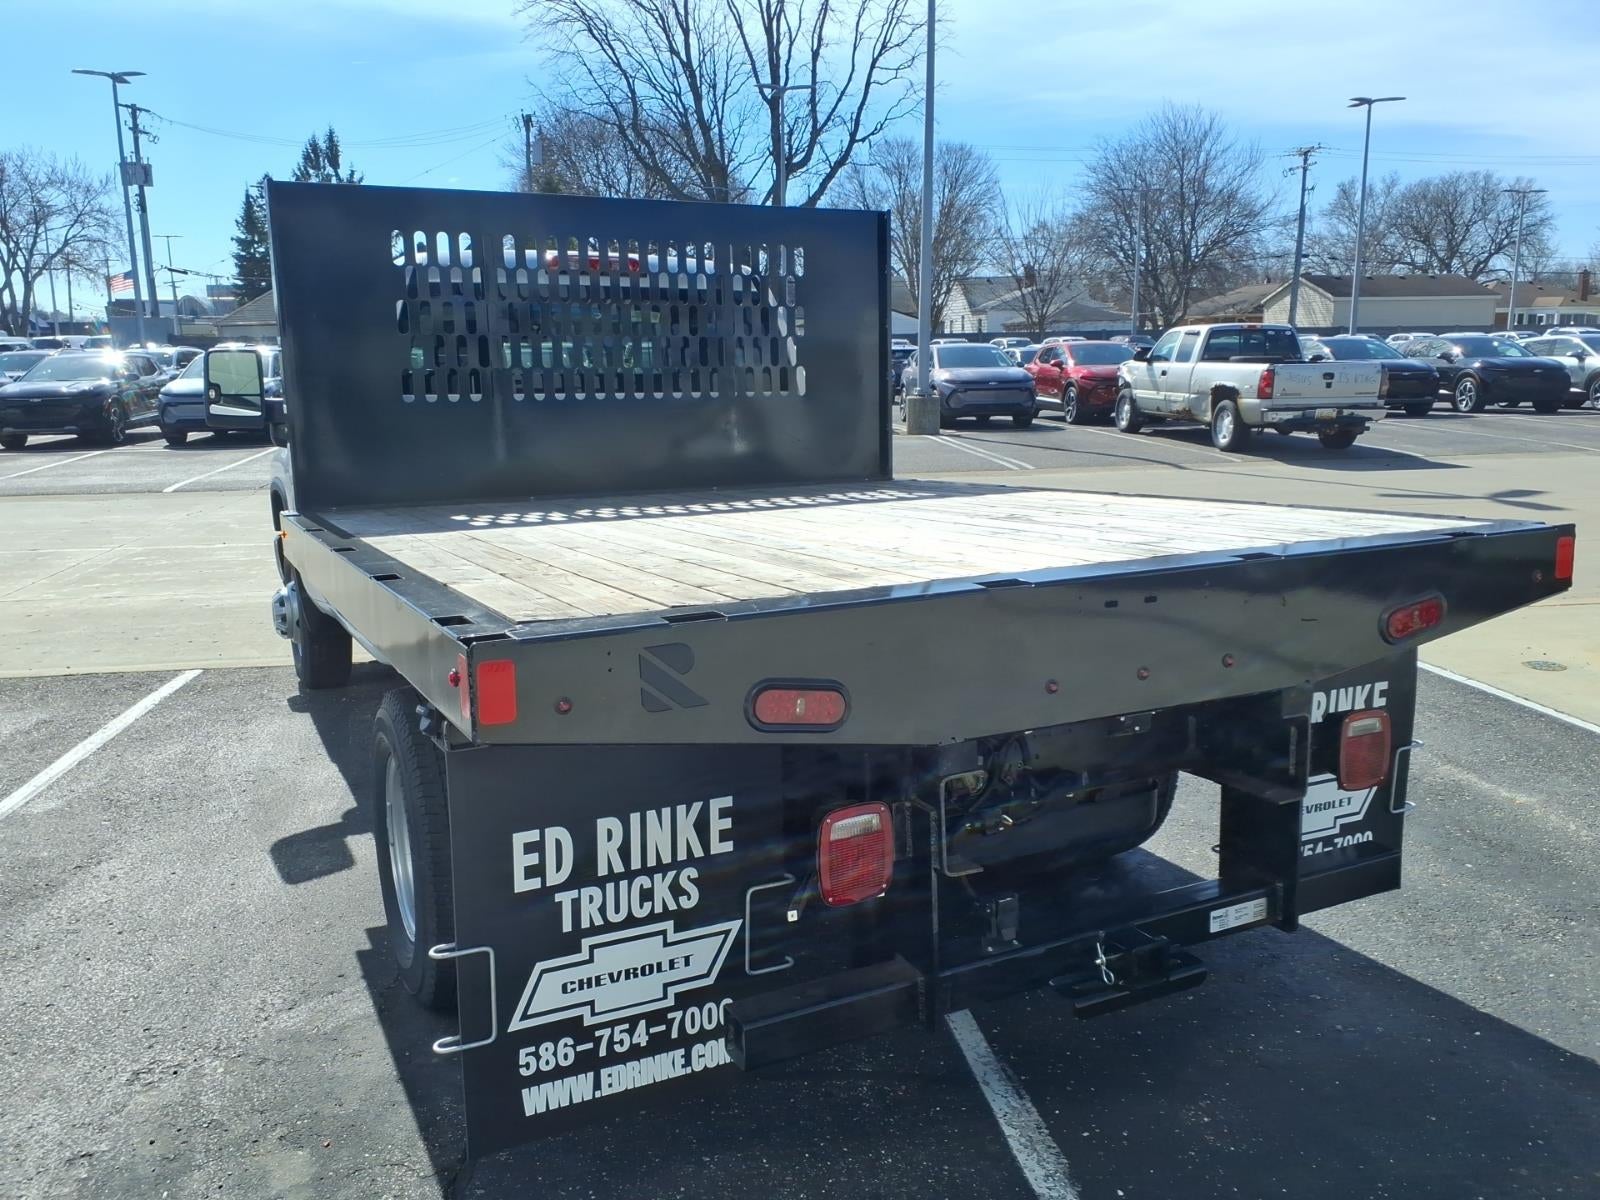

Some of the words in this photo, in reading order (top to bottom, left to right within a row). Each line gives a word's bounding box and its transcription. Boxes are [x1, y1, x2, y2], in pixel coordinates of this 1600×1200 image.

[1311, 681, 1389, 723] RINKE
[1302, 796, 1353, 816] VROLET
[512, 826, 574, 893] ED
[597, 795, 734, 877] RINKE
[1300, 830, 1373, 857] 54-7000
[554, 867, 700, 933] TRUCKS
[561, 954, 695, 995] CHEVROLET
